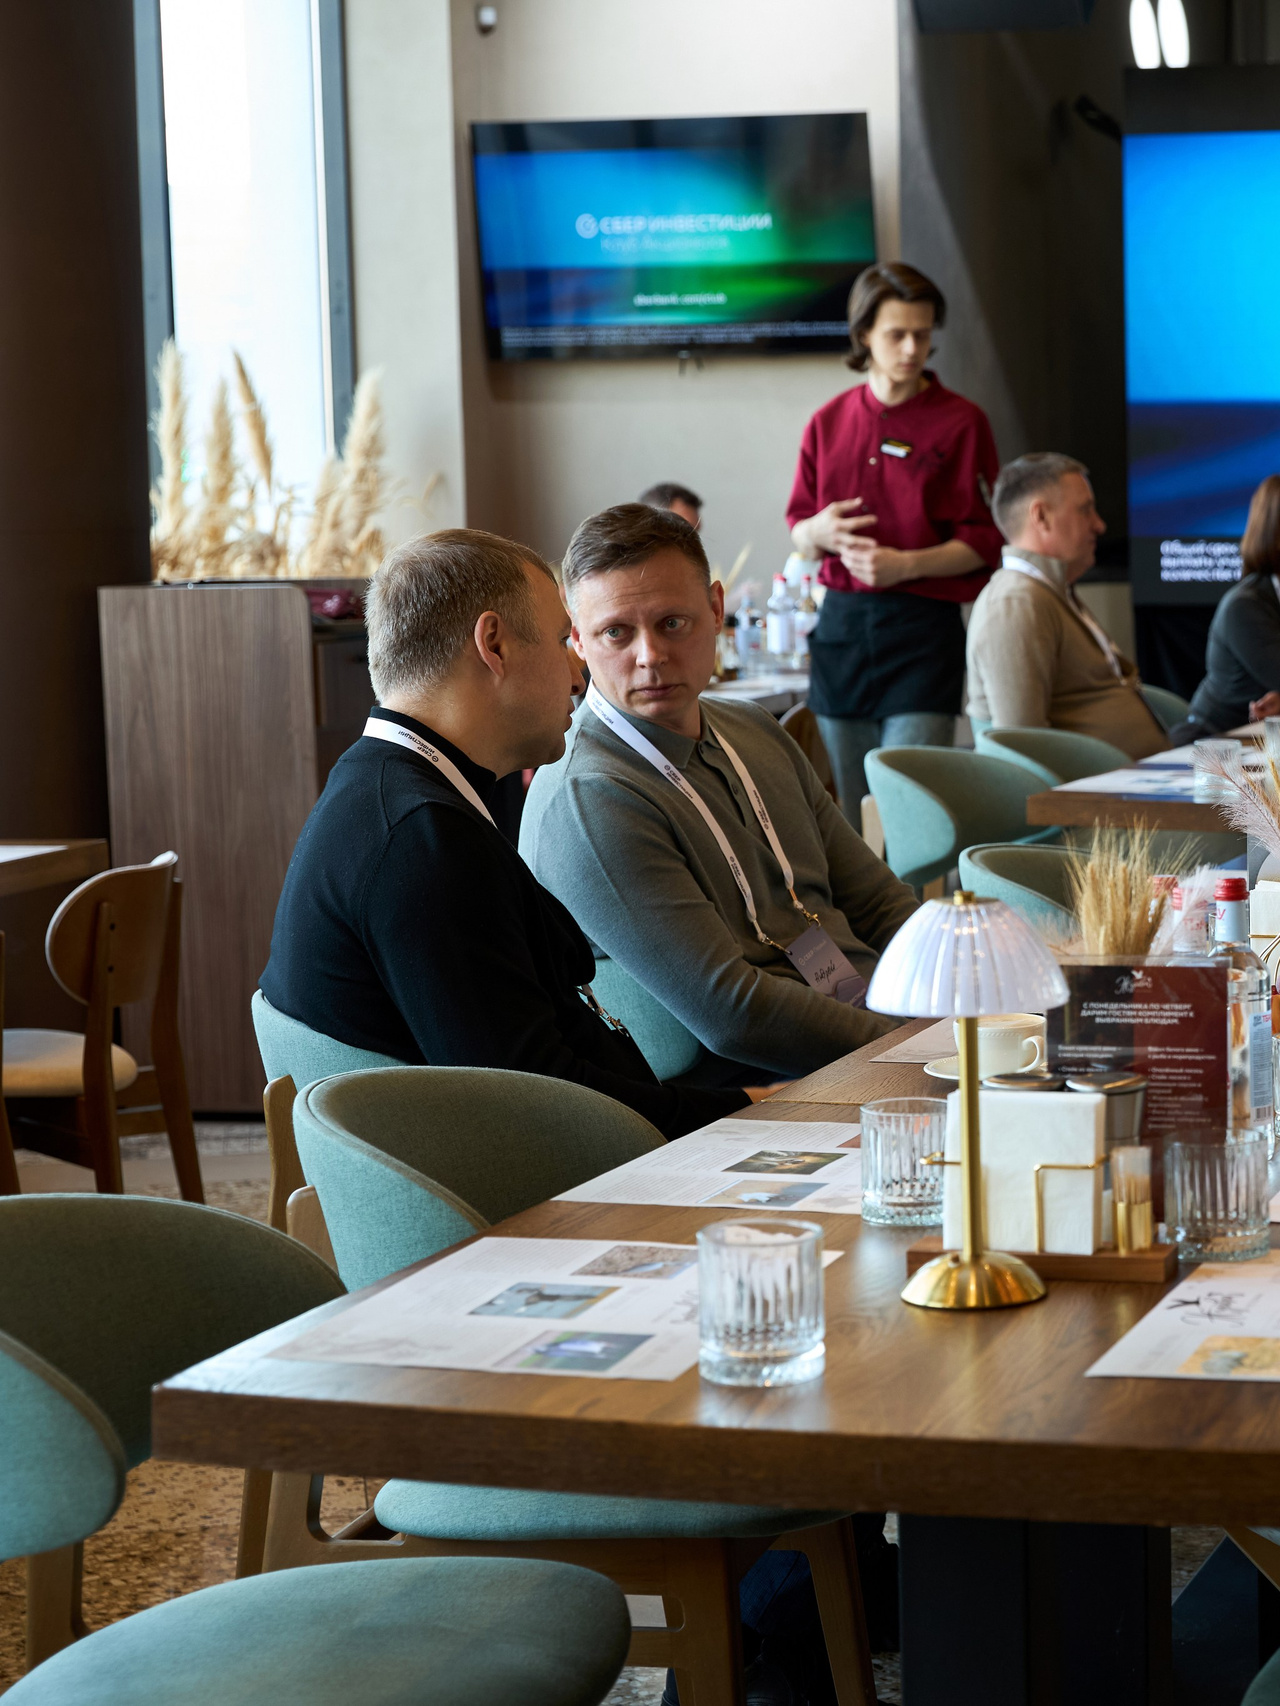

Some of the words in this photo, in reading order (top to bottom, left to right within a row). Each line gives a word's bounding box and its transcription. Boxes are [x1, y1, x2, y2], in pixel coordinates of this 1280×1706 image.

[669, 769, 682, 782] СБЕР
[1089, 1002, 1148, 1010] ПОНЕДЕЛЬНИКА
[1149, 1002, 1160, 1010] ПО
[1160, 1003, 1192, 1011] ЧЕТВЕРГ
[1080, 1009, 1107, 1017] ДАРИМ
